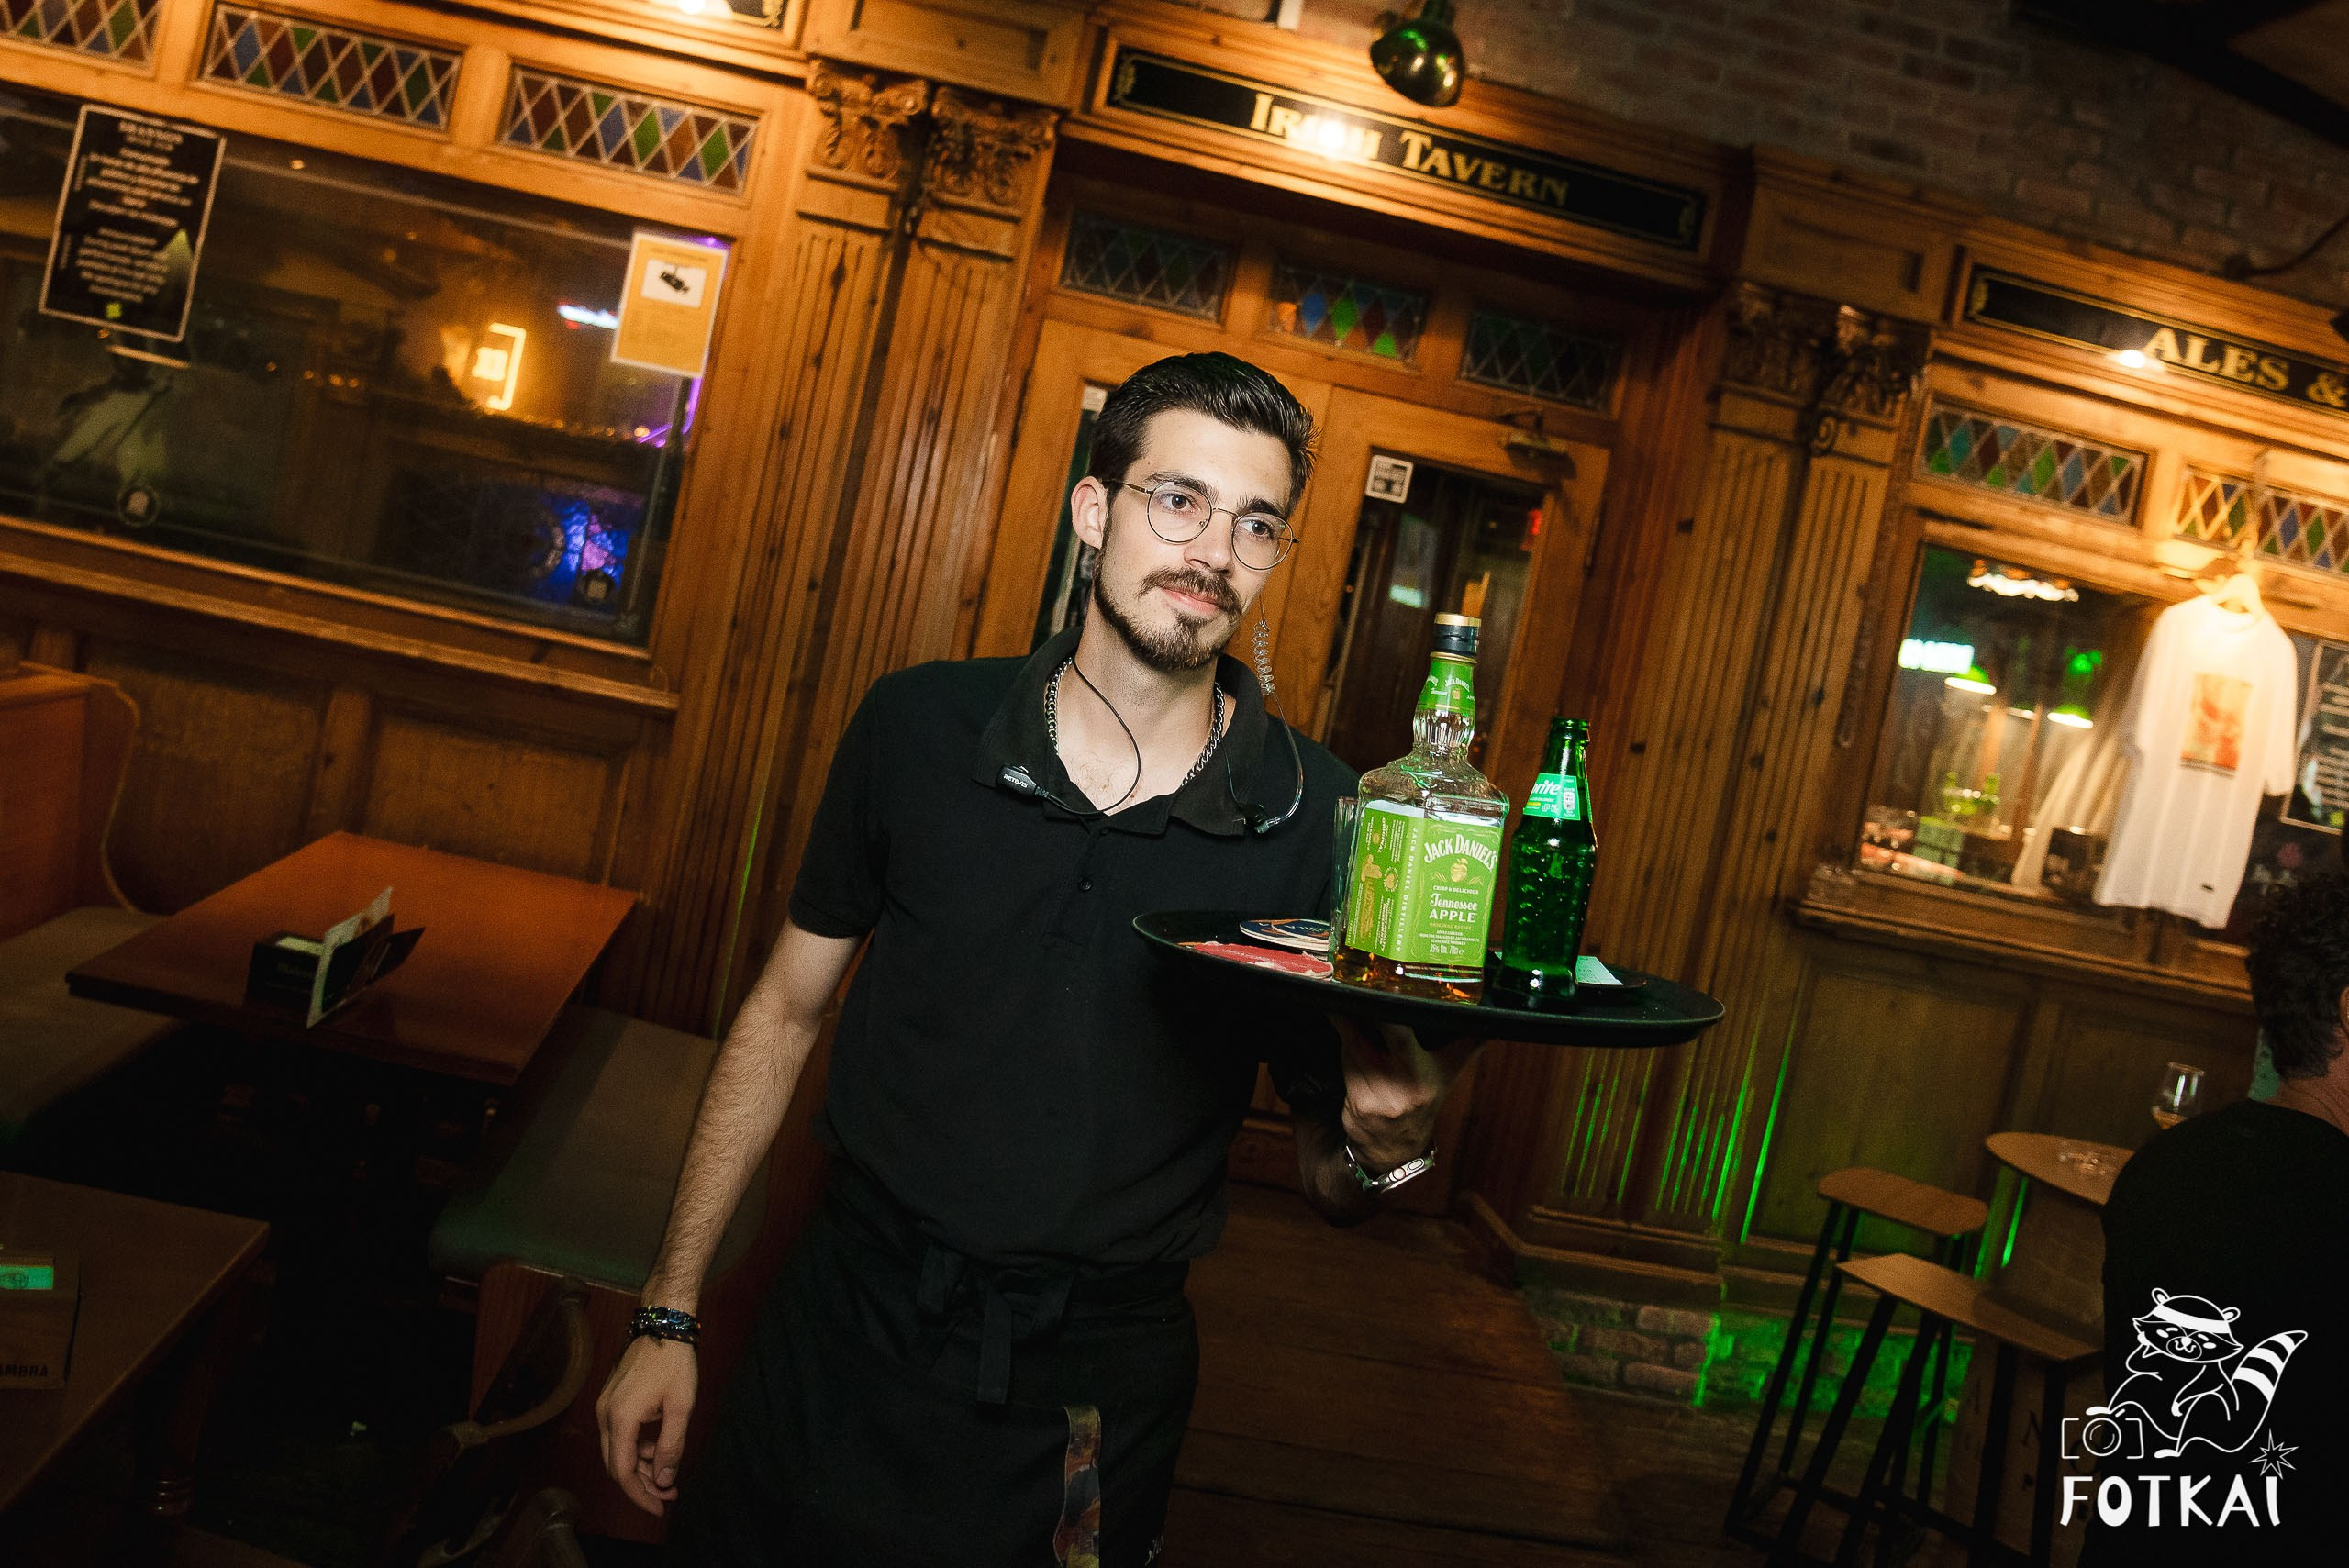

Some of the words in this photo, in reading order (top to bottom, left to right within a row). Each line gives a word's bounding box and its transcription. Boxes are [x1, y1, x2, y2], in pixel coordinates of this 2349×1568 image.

[1401, 129, 1570, 207] TAVERN
[2143, 328, 2290, 391] ALES
[2306, 371, 2349, 408] &
[1406, 855, 1415, 890] DANIEL
[1424, 838, 1453, 863] JACK
[1454, 834, 1498, 873] DANIEL'S
[1429, 908, 1475, 923] APPLE
[1430, 893, 1477, 911] Tennessee
[1396, 895, 1408, 952] DISTILLERY
